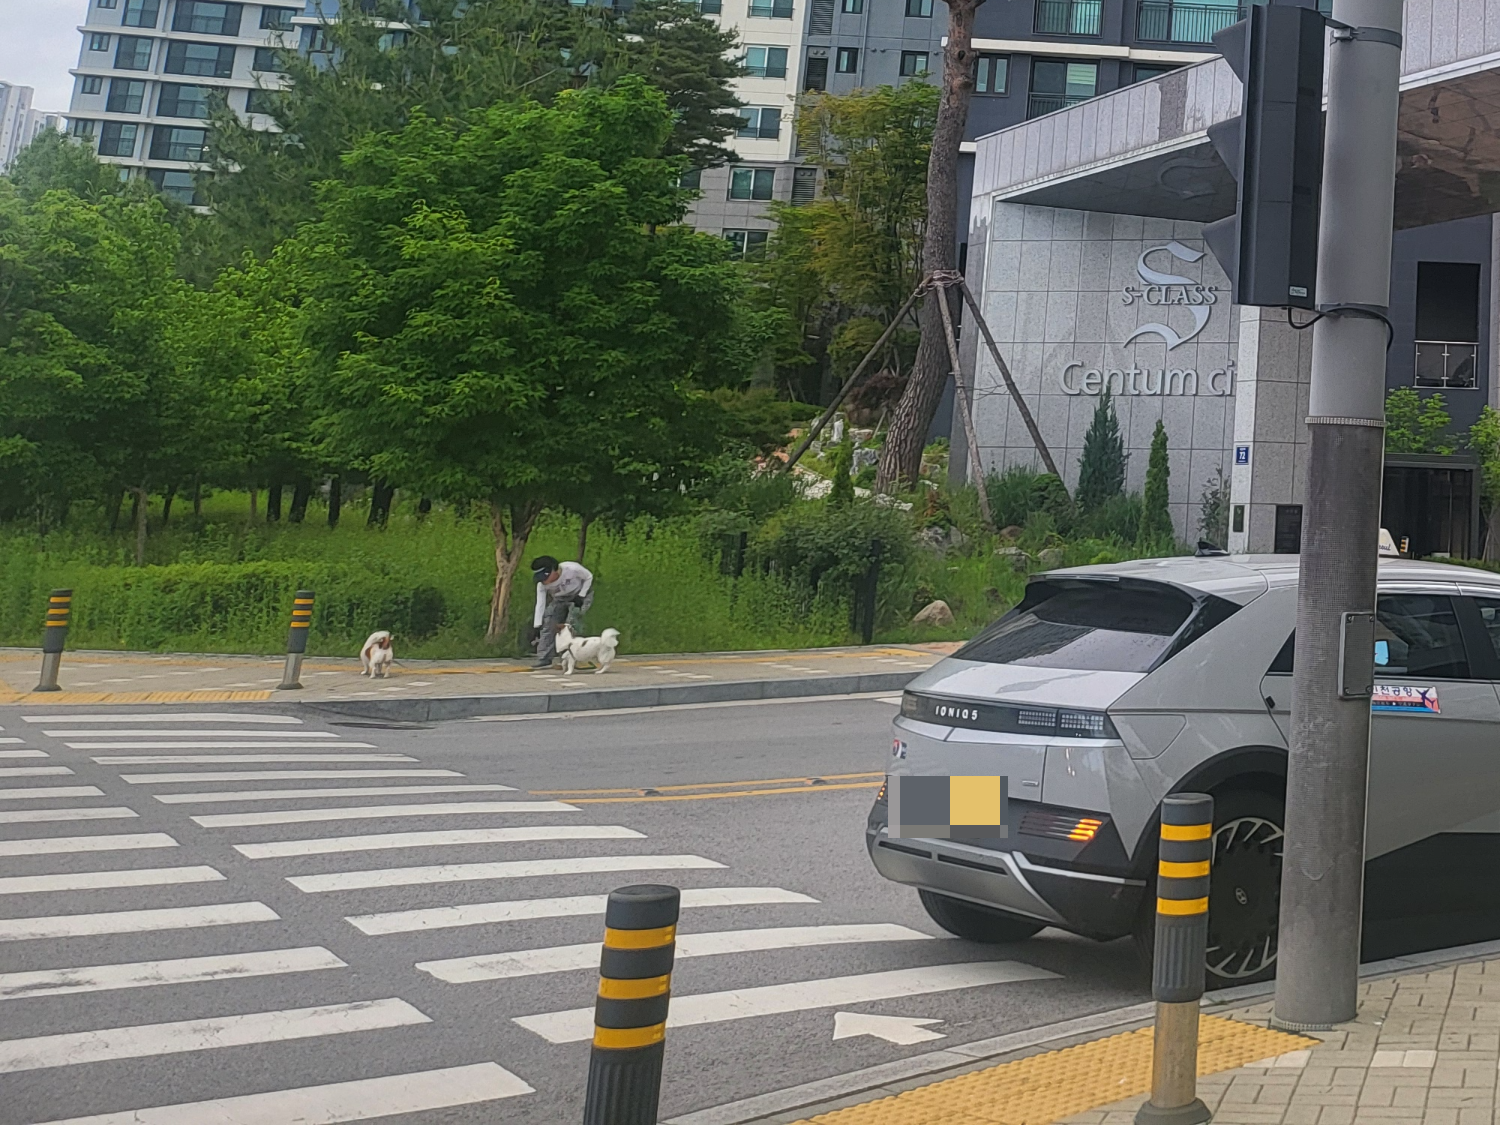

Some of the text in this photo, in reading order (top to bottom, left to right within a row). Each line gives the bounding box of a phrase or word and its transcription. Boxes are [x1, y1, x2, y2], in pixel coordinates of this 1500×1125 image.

[1121, 285, 1218, 306] S-CLASS
[1059, 359, 1237, 396] Centum ci
[935, 705, 978, 721] IONIQ 5
